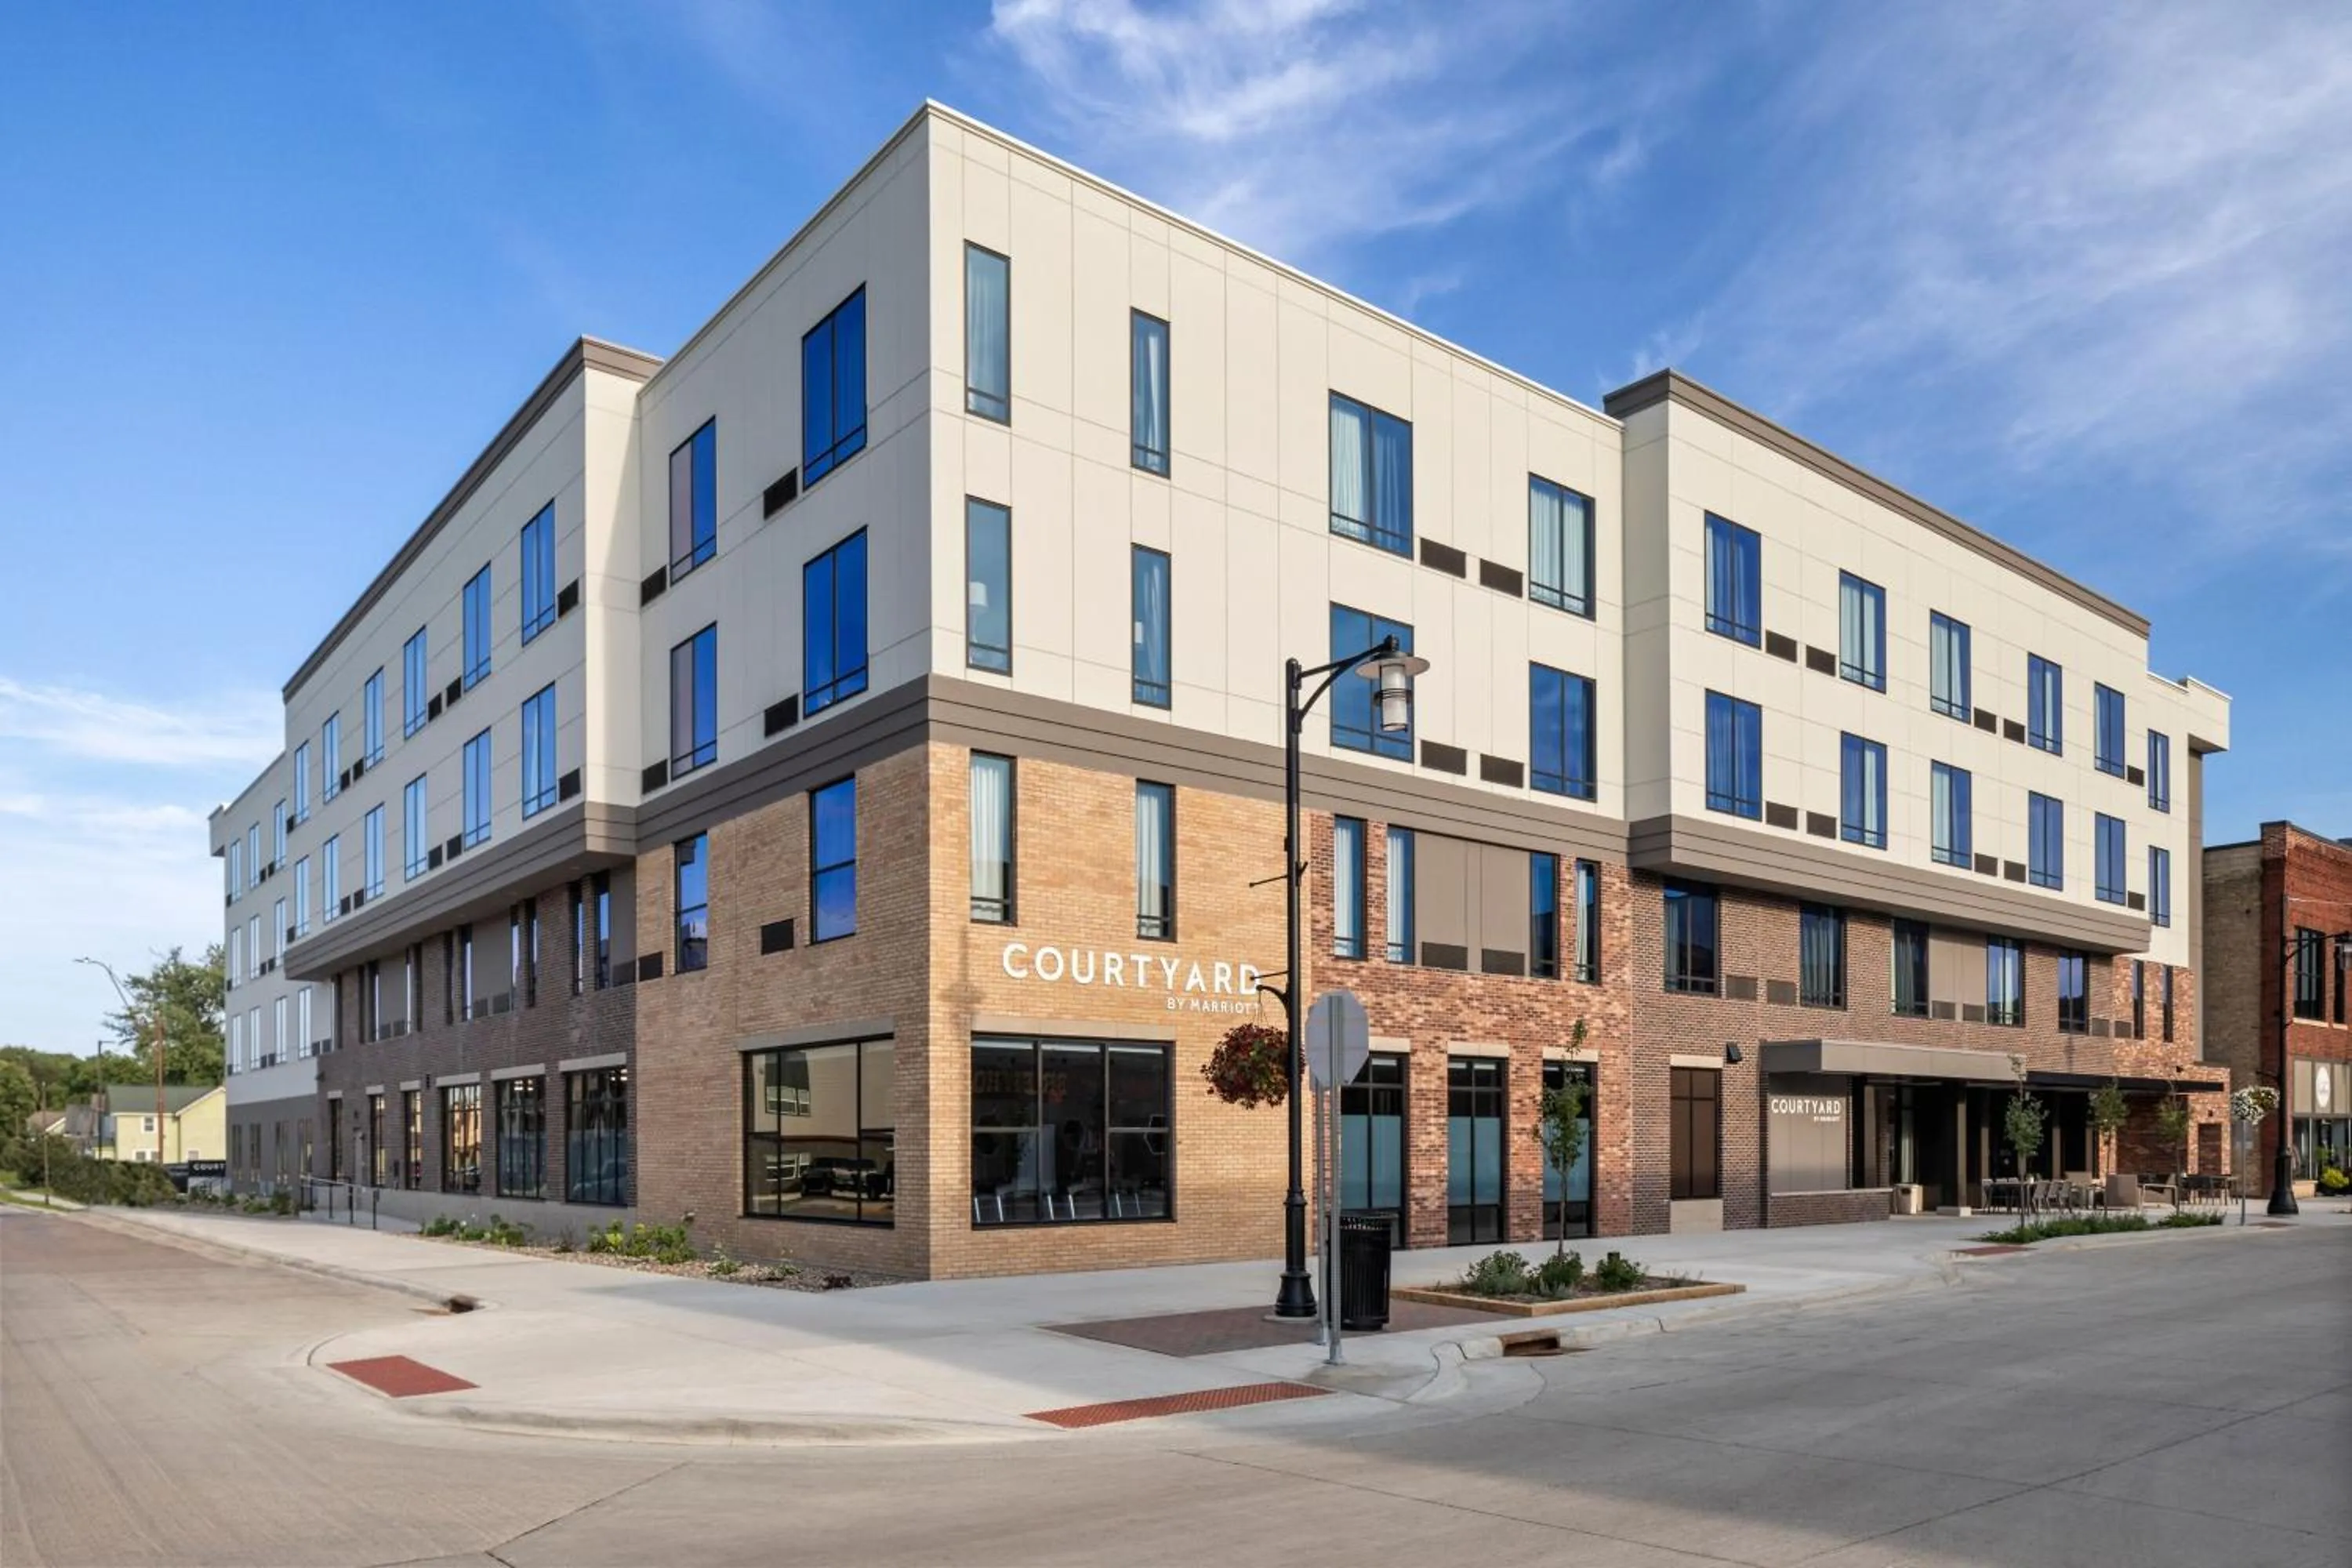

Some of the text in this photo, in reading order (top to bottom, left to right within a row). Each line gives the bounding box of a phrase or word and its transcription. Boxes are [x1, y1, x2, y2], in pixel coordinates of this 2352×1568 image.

[1003, 943, 1260, 995] COURTYARD
[1167, 996, 1185, 1010] BY
[1771, 1098, 1841, 1114] COURTYARD
